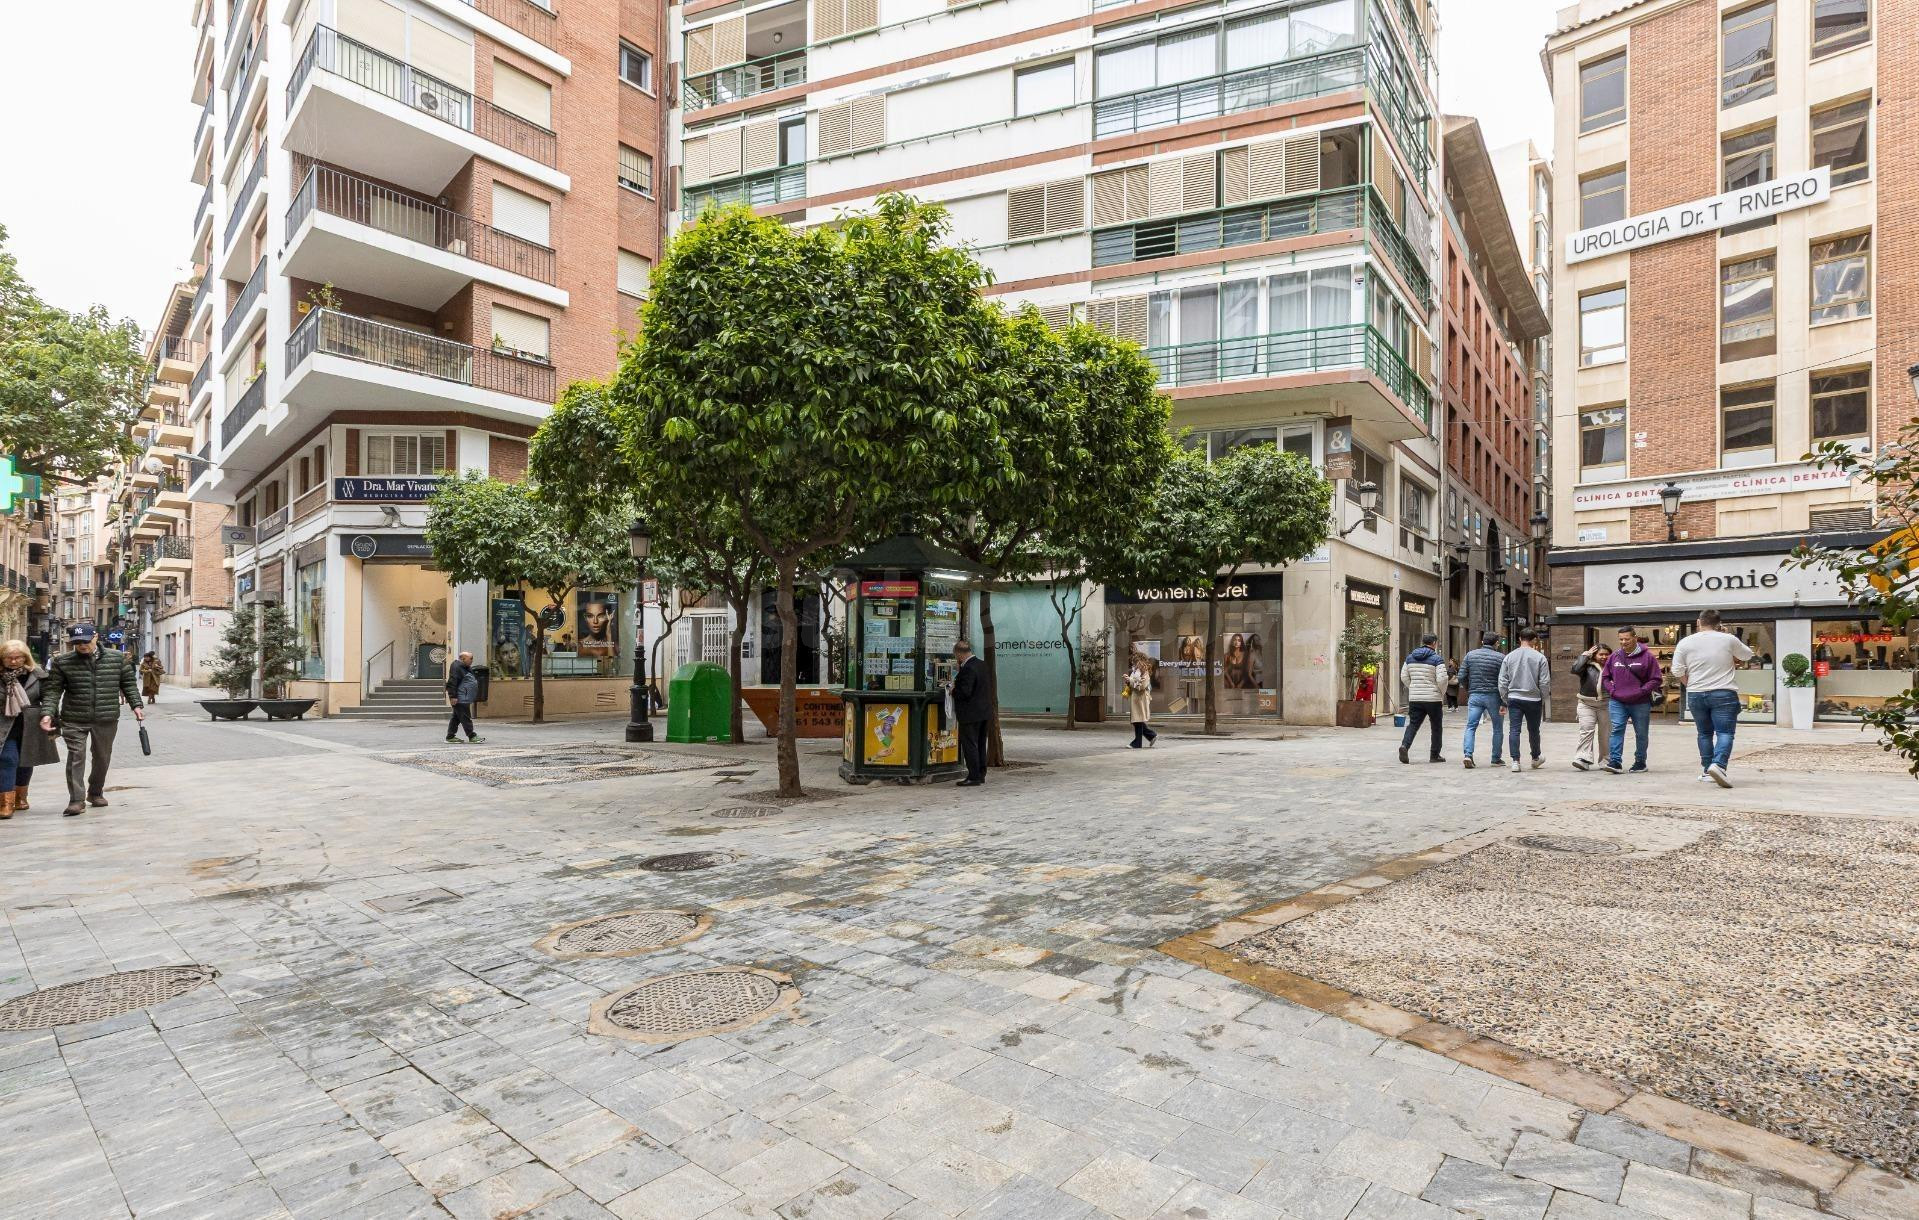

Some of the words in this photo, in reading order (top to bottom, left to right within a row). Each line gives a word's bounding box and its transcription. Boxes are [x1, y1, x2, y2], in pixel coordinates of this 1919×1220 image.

[1574, 217, 1670, 254] UROLOGIA
[1680, 210, 1704, 228] Dr.
[1793, 471, 1847, 482] DENTAL
[363, 481, 384, 491] Dra.
[387, 481, 405, 491] Mar
[1626, 489, 1663, 498] DENTA
[1679, 569, 1779, 592] Conie
[994, 639, 1067, 650] omen'secret
